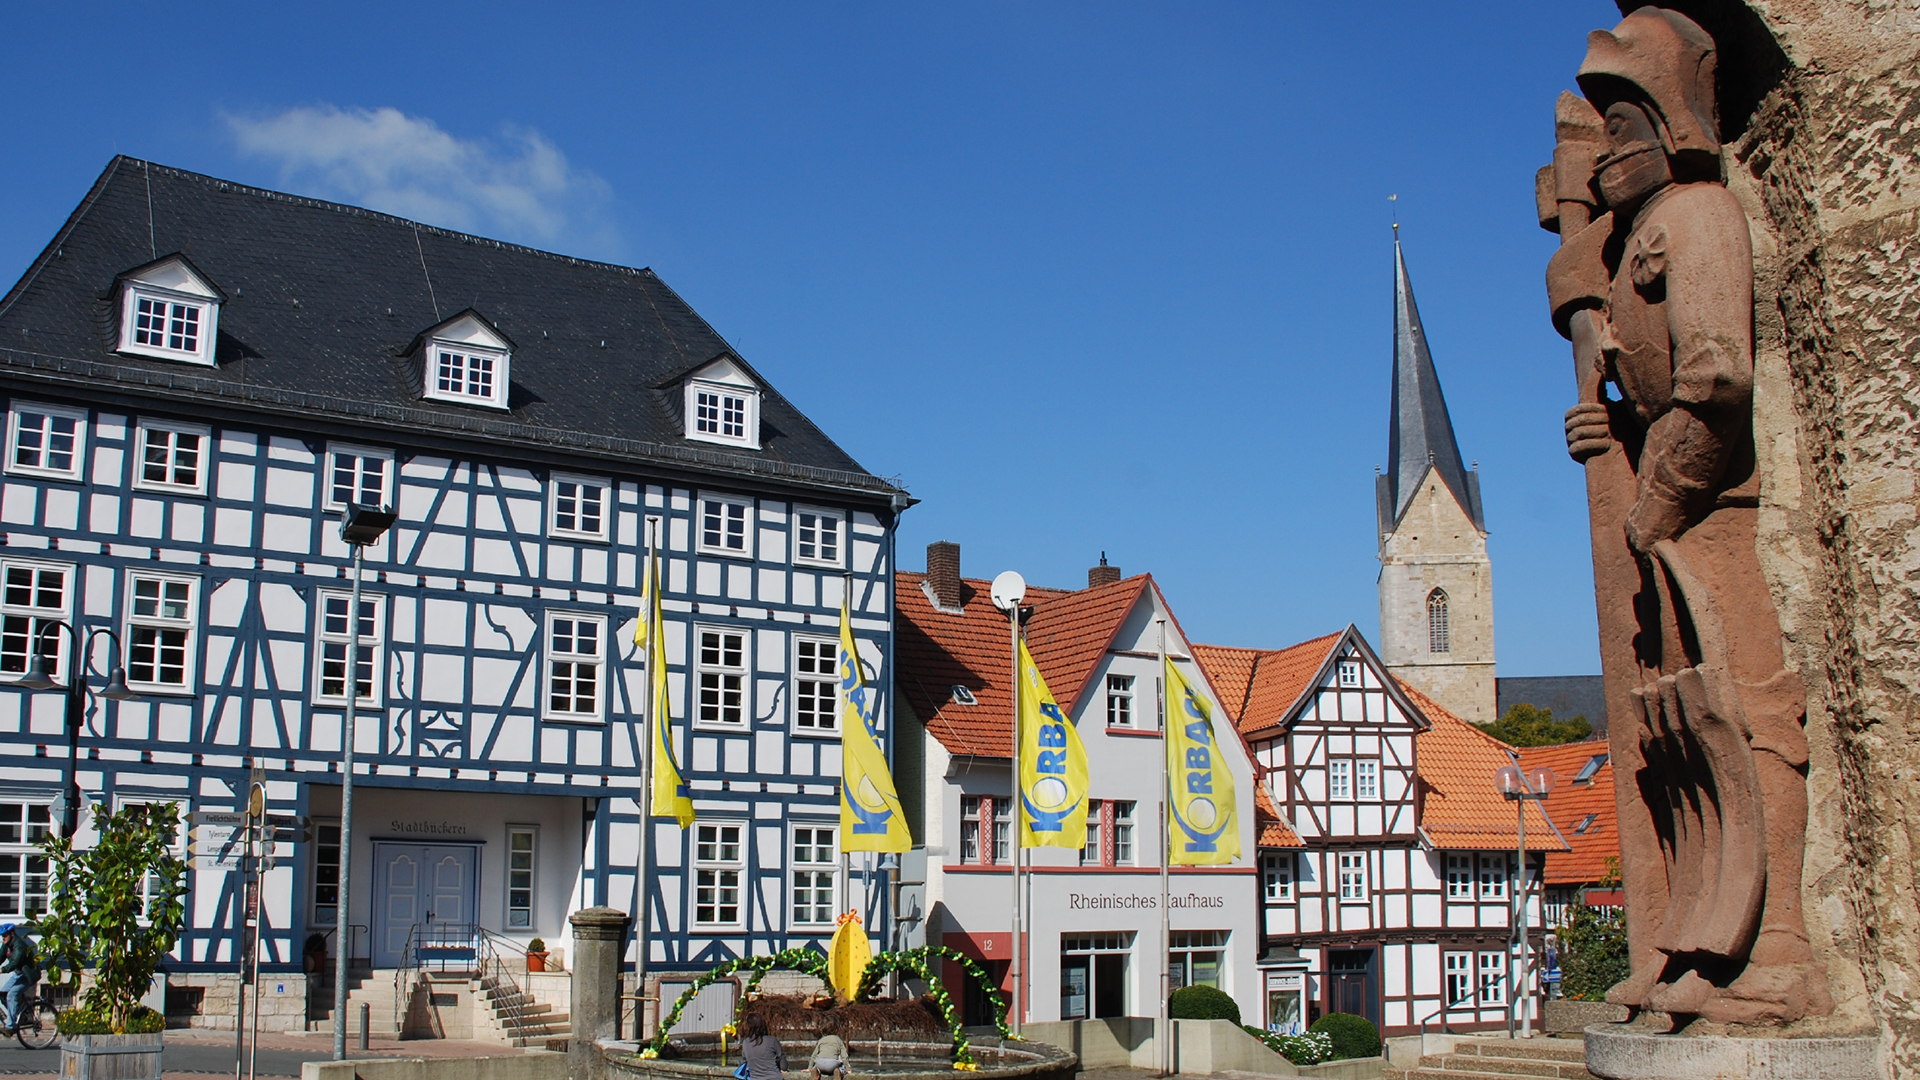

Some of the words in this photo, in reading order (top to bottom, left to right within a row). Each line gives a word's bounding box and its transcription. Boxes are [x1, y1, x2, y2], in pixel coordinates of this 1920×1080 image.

[1022, 702, 1084, 832] KORBA
[1170, 686, 1231, 853] KORBAC
[391, 820, 467, 834] Stadtbücherei
[1069, 893, 1157, 910] Rheinisches
[983, 939, 993, 951] 12
